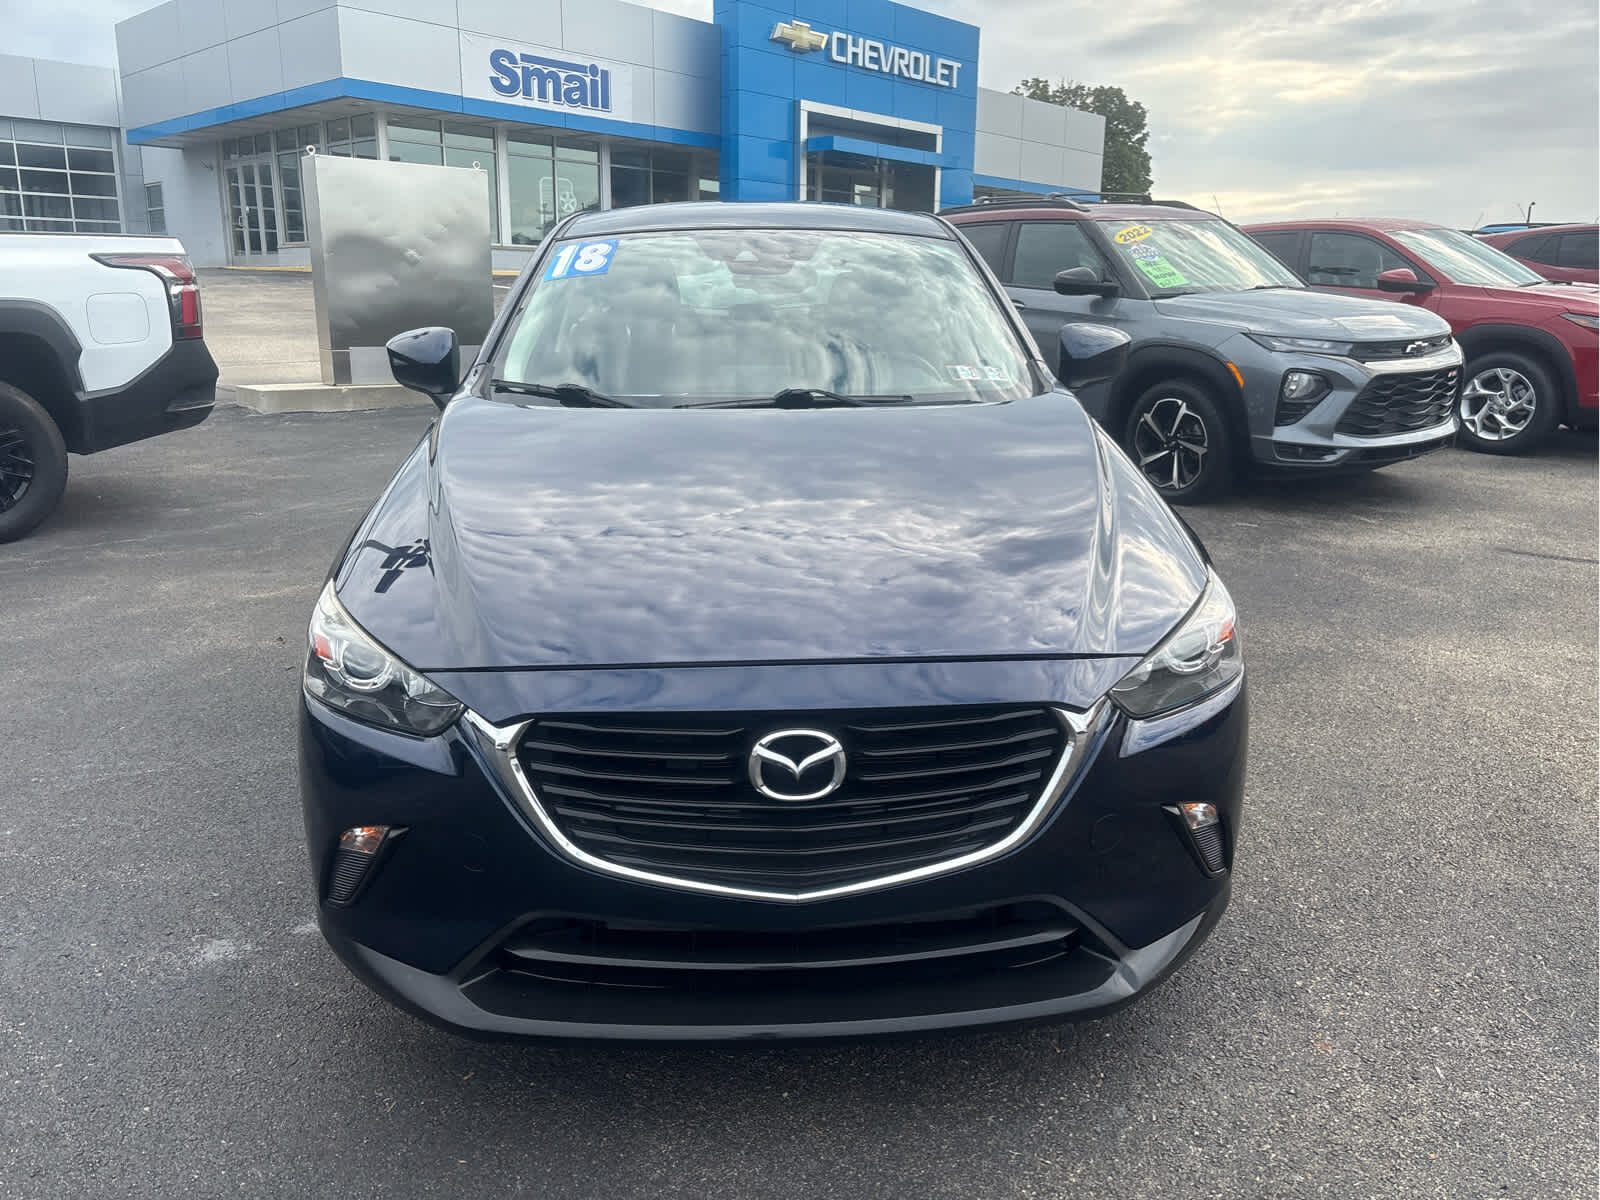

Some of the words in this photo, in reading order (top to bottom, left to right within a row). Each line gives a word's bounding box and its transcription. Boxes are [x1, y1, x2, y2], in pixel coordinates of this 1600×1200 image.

[489, 48, 612, 112] Smail
[831, 31, 962, 88] CHEVROLET
[1119, 225, 1151, 242] 2022
[551, 243, 613, 278] 18
